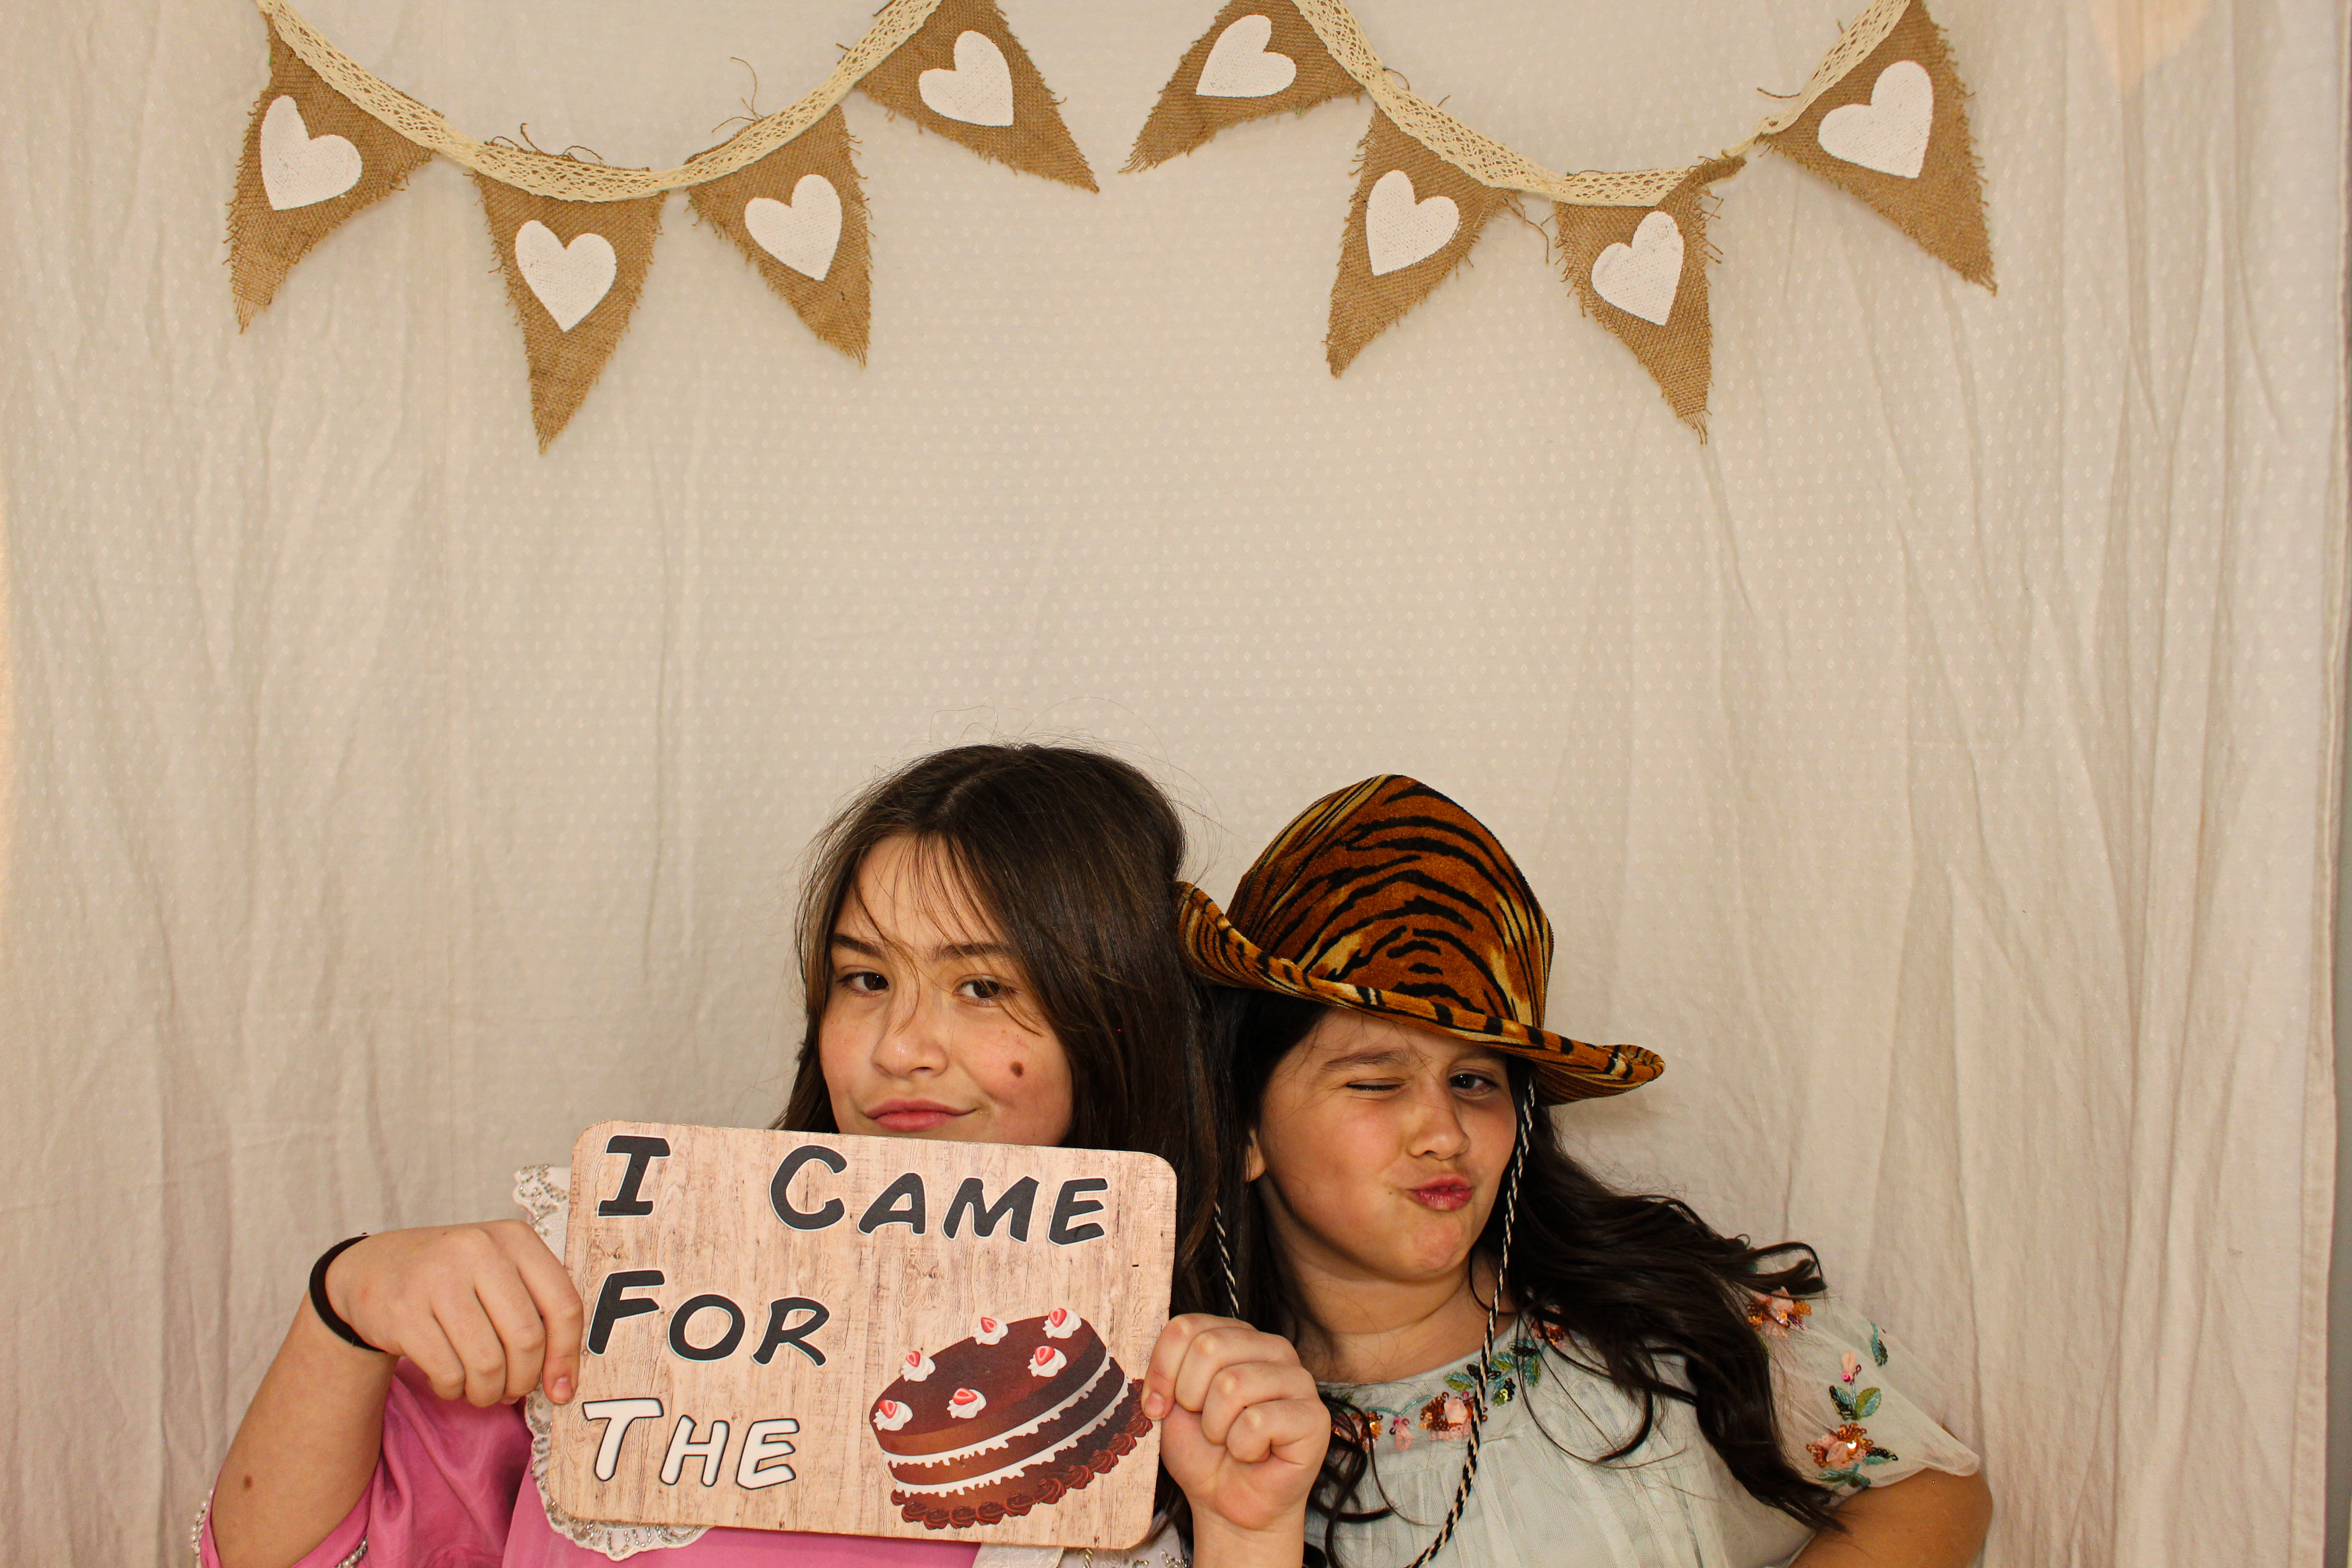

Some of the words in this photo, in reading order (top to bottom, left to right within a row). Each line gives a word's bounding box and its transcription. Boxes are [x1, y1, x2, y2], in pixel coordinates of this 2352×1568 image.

[597, 1134, 671, 1217] I
[770, 1144, 1110, 1246] CAME
[585, 1269, 831, 1367] FOR
[581, 1397, 800, 1491] THE
